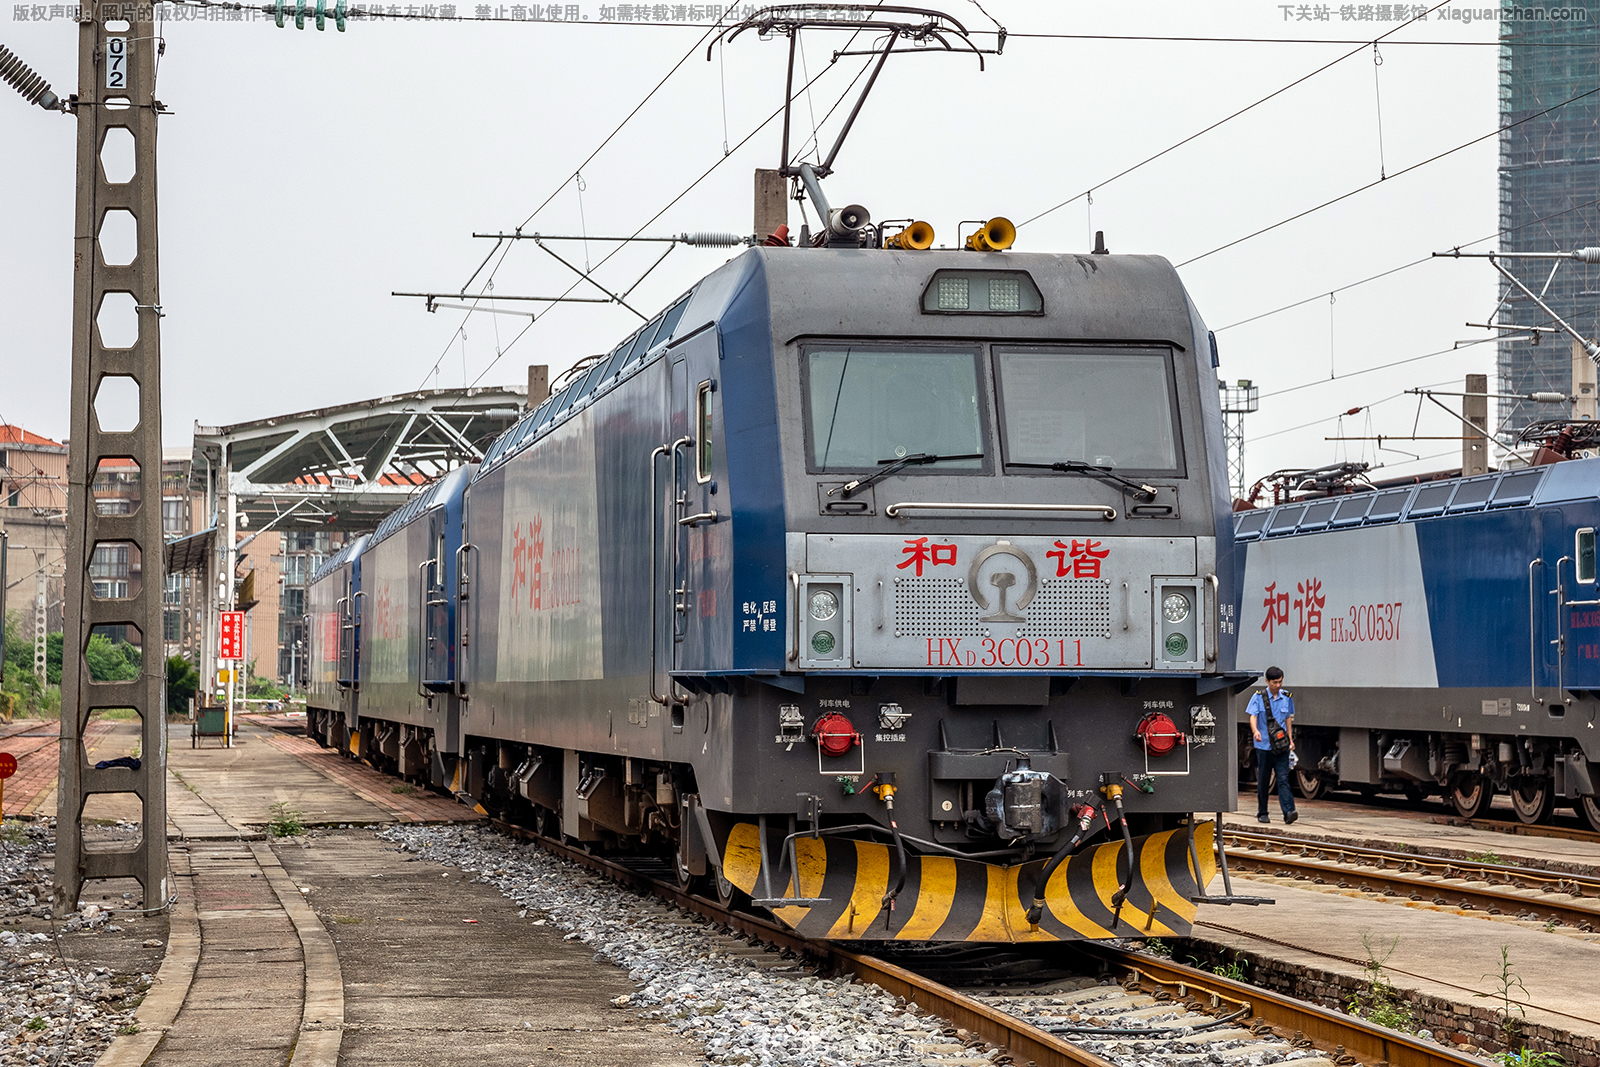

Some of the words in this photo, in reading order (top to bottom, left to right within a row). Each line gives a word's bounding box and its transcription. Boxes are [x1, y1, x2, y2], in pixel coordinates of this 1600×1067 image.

[110, 38, 124, 87] 072
[512, 512, 544, 616] 和谐
[896, 537, 958, 577] 和
[1046, 538, 1111, 579] 谐
[742, 601, 757, 614] 电化
[763, 600, 777, 613] 区段
[1261, 577, 1326, 644] 和谐
[742, 619, 757, 632] 严禁
[763, 618, 777, 632] 攀登
[819, 699, 851, 708] 列车供电
[1143, 700, 1174, 709] 列车供电
[875, 733, 906, 742] 集控插座
